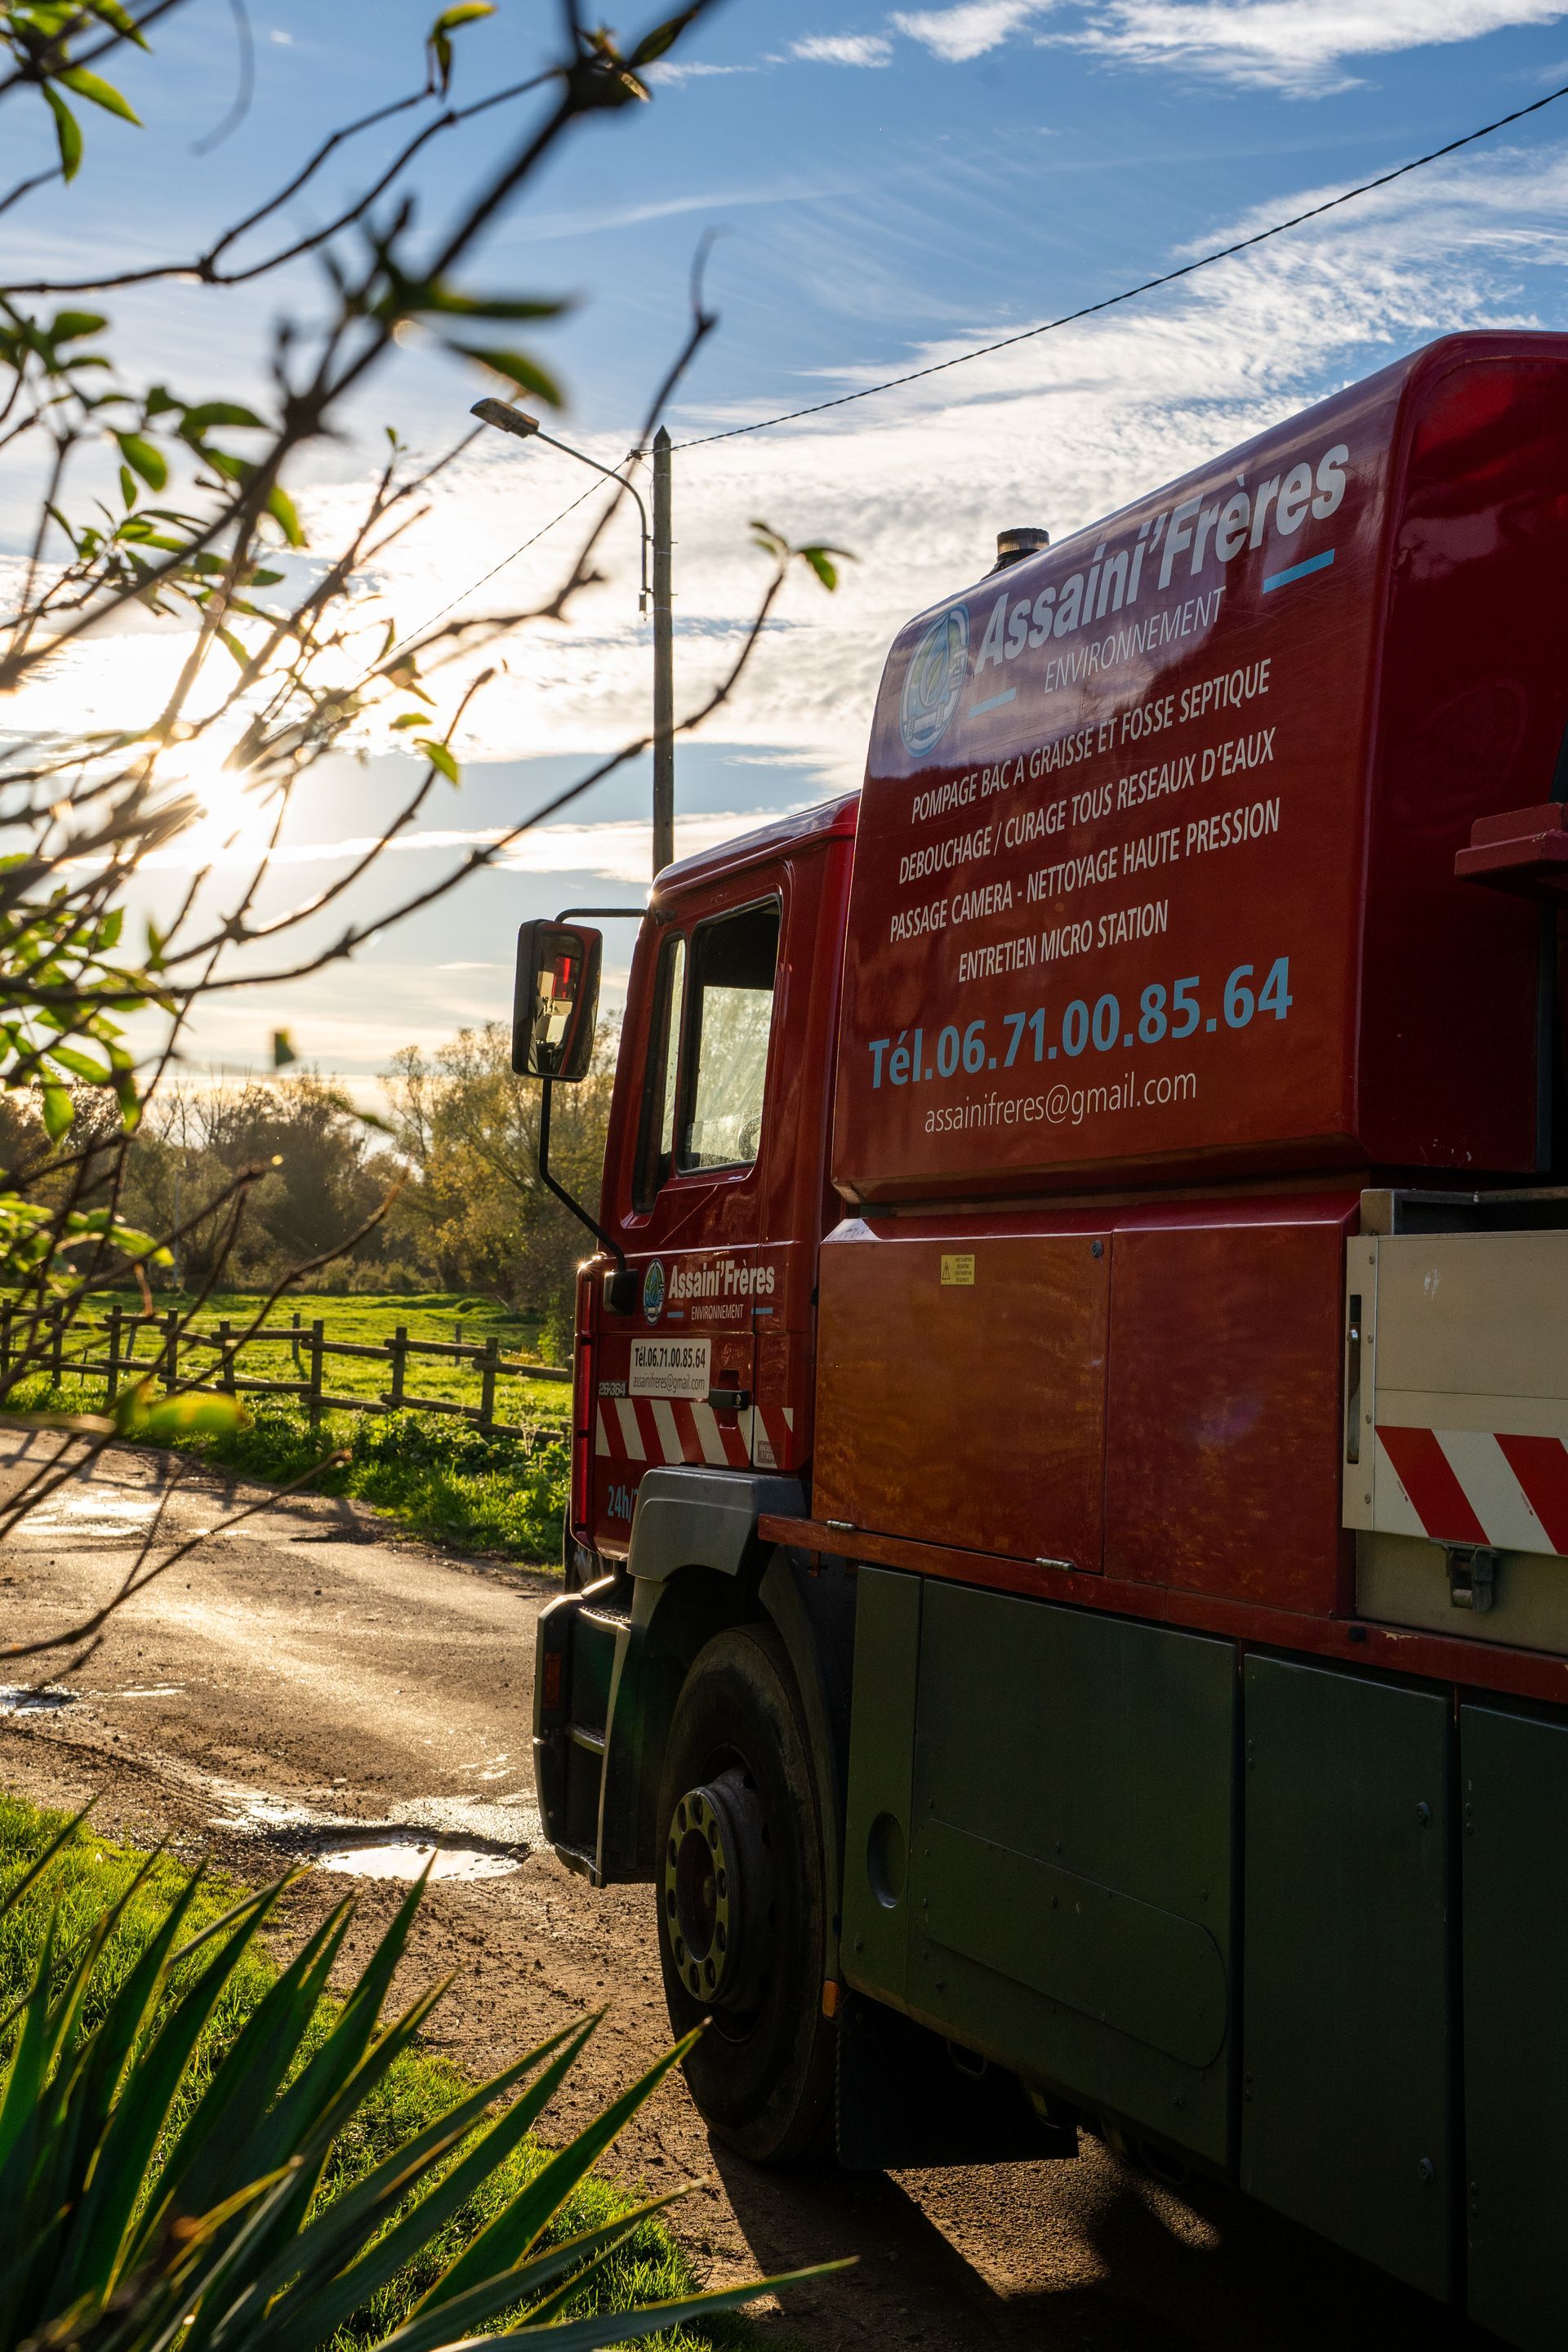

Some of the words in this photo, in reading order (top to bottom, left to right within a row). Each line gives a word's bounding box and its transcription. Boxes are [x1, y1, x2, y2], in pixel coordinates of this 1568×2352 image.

[973, 443, 1349, 677] Assaini'Frères
[1045, 586, 1226, 694] ENVIRONNEMENT
[911, 773, 977, 824] POMPAGE
[980, 760, 1012, 797] BAC
[1013, 753, 1025, 786] A
[1029, 727, 1094, 779] GRAISSE
[1098, 718, 1117, 754] ET
[1122, 695, 1175, 744] FOSSE
[1179, 658, 1272, 723] SEPTIQUE
[899, 826, 992, 885] DEBOUCHAGE
[994, 822, 1002, 856] /
[1005, 800, 1067, 849] CURAGE
[1071, 783, 1113, 826] TOUS
[1117, 753, 1196, 811] RESEAUX
[1200, 728, 1276, 783] D'EAUX
[890, 898, 947, 942] PASSAGE
[951, 880, 1013, 924] CAMERA
[1027, 846, 1117, 904] NETTOYAGE
[1123, 826, 1181, 875] HAUTE
[1186, 797, 1280, 858] PRESSION
[959, 936, 1036, 983] ENTRETIEN
[1040, 920, 1094, 963] MICRO
[1098, 899, 1169, 946] STATION
[869, 956, 1293, 1089] Tél.06.71.00.85.64
[924, 1071, 1197, 1133] assainifreres@gmail.com
[668, 1259, 775, 1298] Assaini'Frères
[691, 1304, 744, 1321] ENVIRONNEMENT
[633, 1372, 705, 1393] assainifreres@gmail.com
[635, 1346, 706, 1369] Tél.06.71.00.85.64
